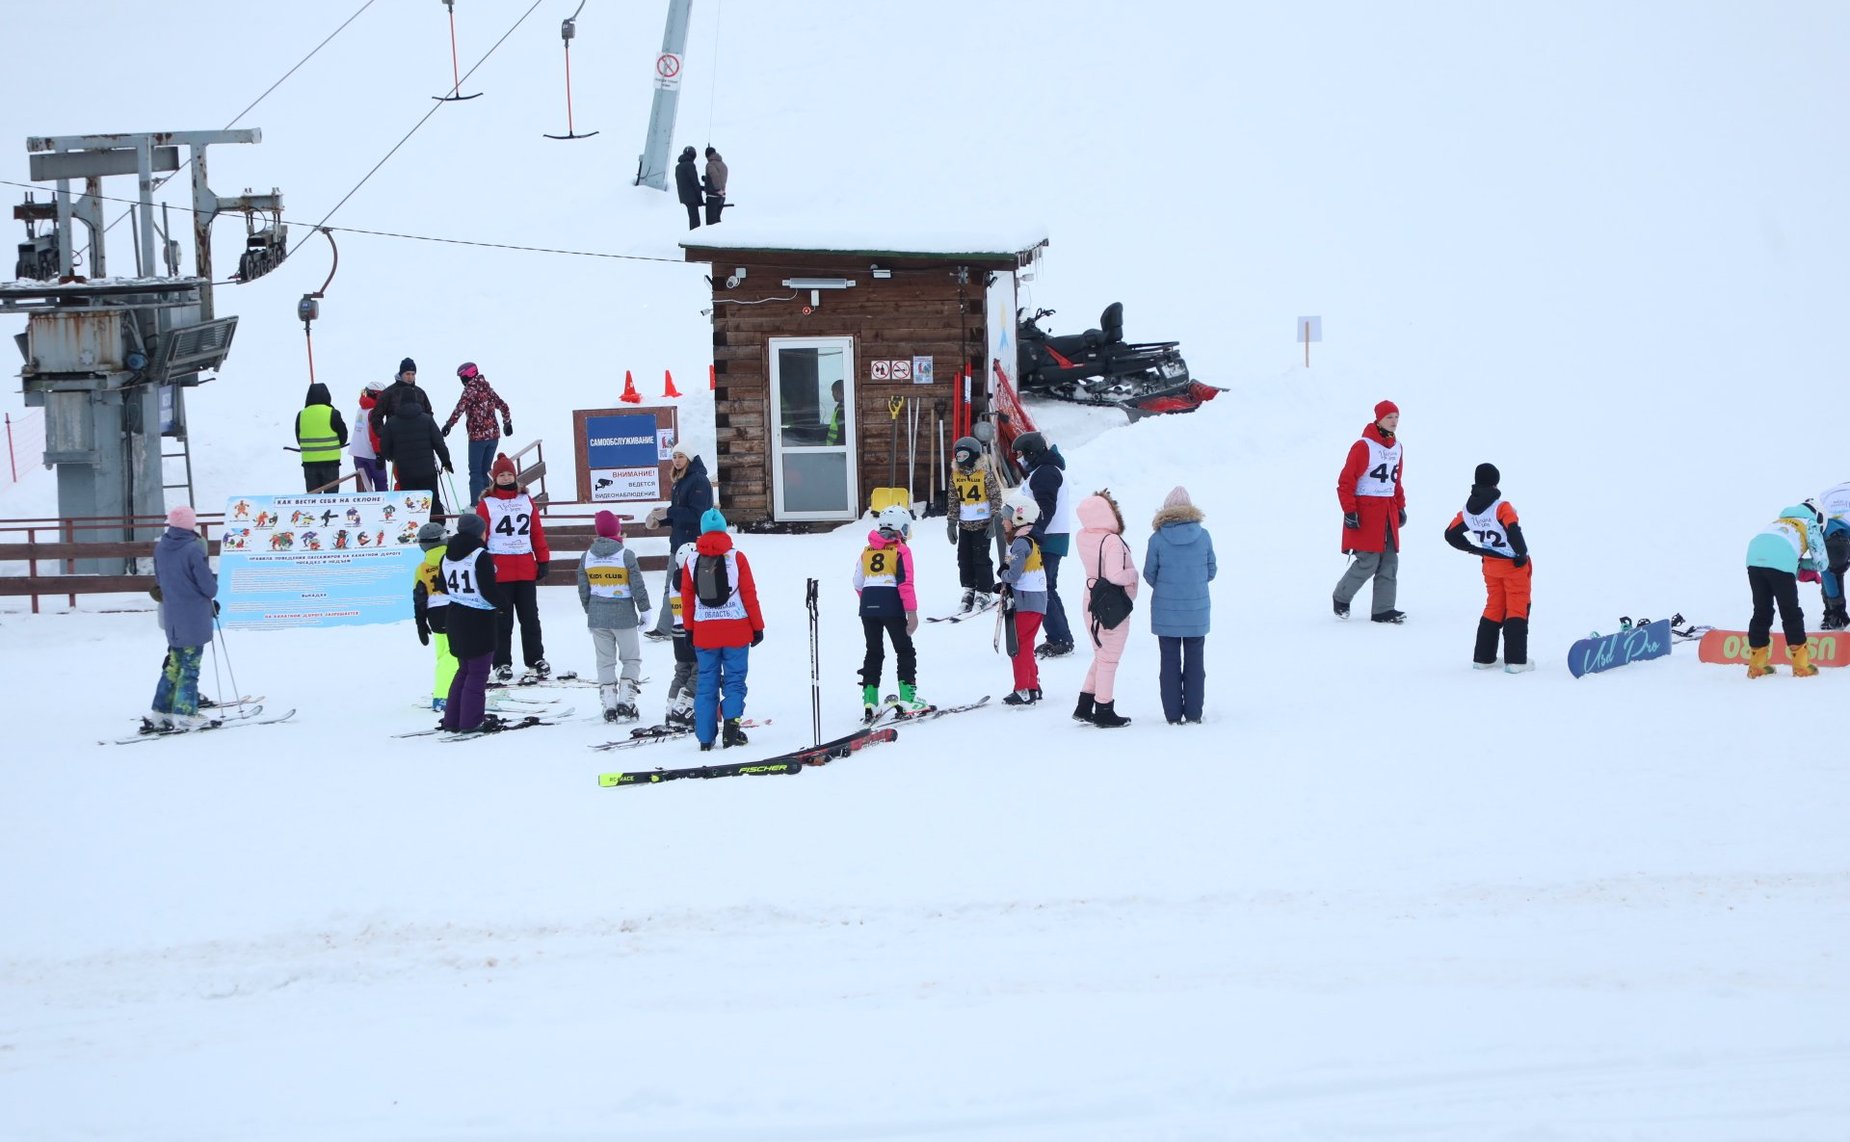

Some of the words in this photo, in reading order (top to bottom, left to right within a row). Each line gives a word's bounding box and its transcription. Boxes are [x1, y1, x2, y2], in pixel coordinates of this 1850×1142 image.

[590, 436, 654, 446] САМООБСЛУЖИВАНИЕ
[612, 470, 655, 478] ВНИМАНИЕ!
[594, 491, 656, 499] ВИДЕОНАБЛЮДЕНИЕ
[957, 485, 981, 501] 14
[495, 513, 529, 536] 42
[1473, 530, 1506, 548] 72
[870, 553, 884, 572] 8
[448, 570, 475, 594] 41
[704, 610, 731, 619] ОБЛАСТЬ
[1623, 628, 1661, 664] Pro
[1723, 635, 1774, 660] RO
[738, 764, 788, 774] FISCHER
